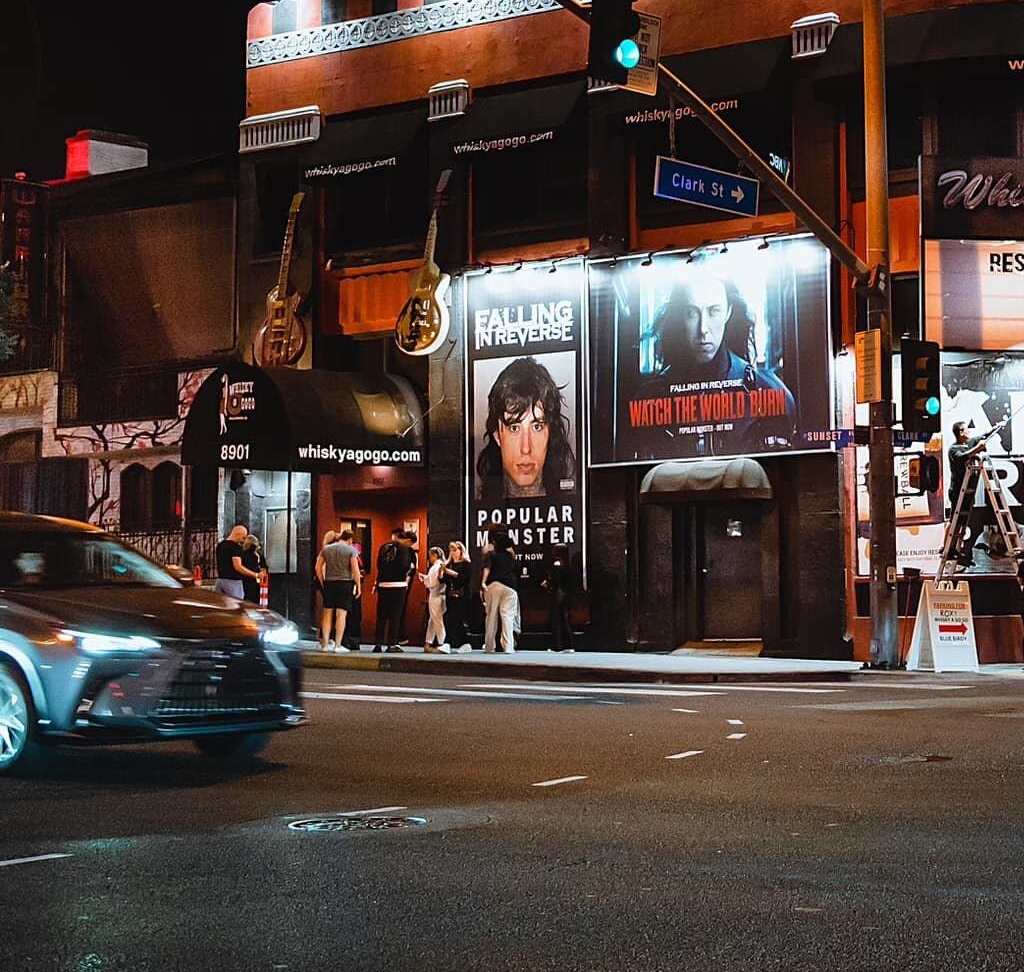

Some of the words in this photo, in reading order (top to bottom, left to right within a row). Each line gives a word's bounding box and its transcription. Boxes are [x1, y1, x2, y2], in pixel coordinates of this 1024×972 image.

[625, 98, 738, 124] whiskygocom
[454, 130, 553, 154] whiskyagogo.com
[304, 156, 396, 178] whiskyagogo.com
[672, 173, 705, 194] Clark
[711, 182, 724, 198] St
[475, 300, 574, 329] FALLING
[475, 327, 493, 350] IN
[495, 321, 574, 347] REVERSE
[670, 383, 700, 393] FALLING
[701, 381, 709, 389] IN
[709, 379, 744, 389] REVERSE
[628, 397, 673, 428] WATCH
[674, 395, 698, 424] THE
[700, 391, 746, 421] WORLD
[749, 388, 786, 418] BURN
[807, 431, 842, 441] SUNSET
[220, 444, 250, 460] 8901
[298, 444, 421, 464] whiskyagogo.com
[899, 456, 912, 510] REWBALL
[477, 505, 573, 526] POPULAR
[476, 527, 575, 547] MNSTER
[525, 553, 544, 561] NOW
